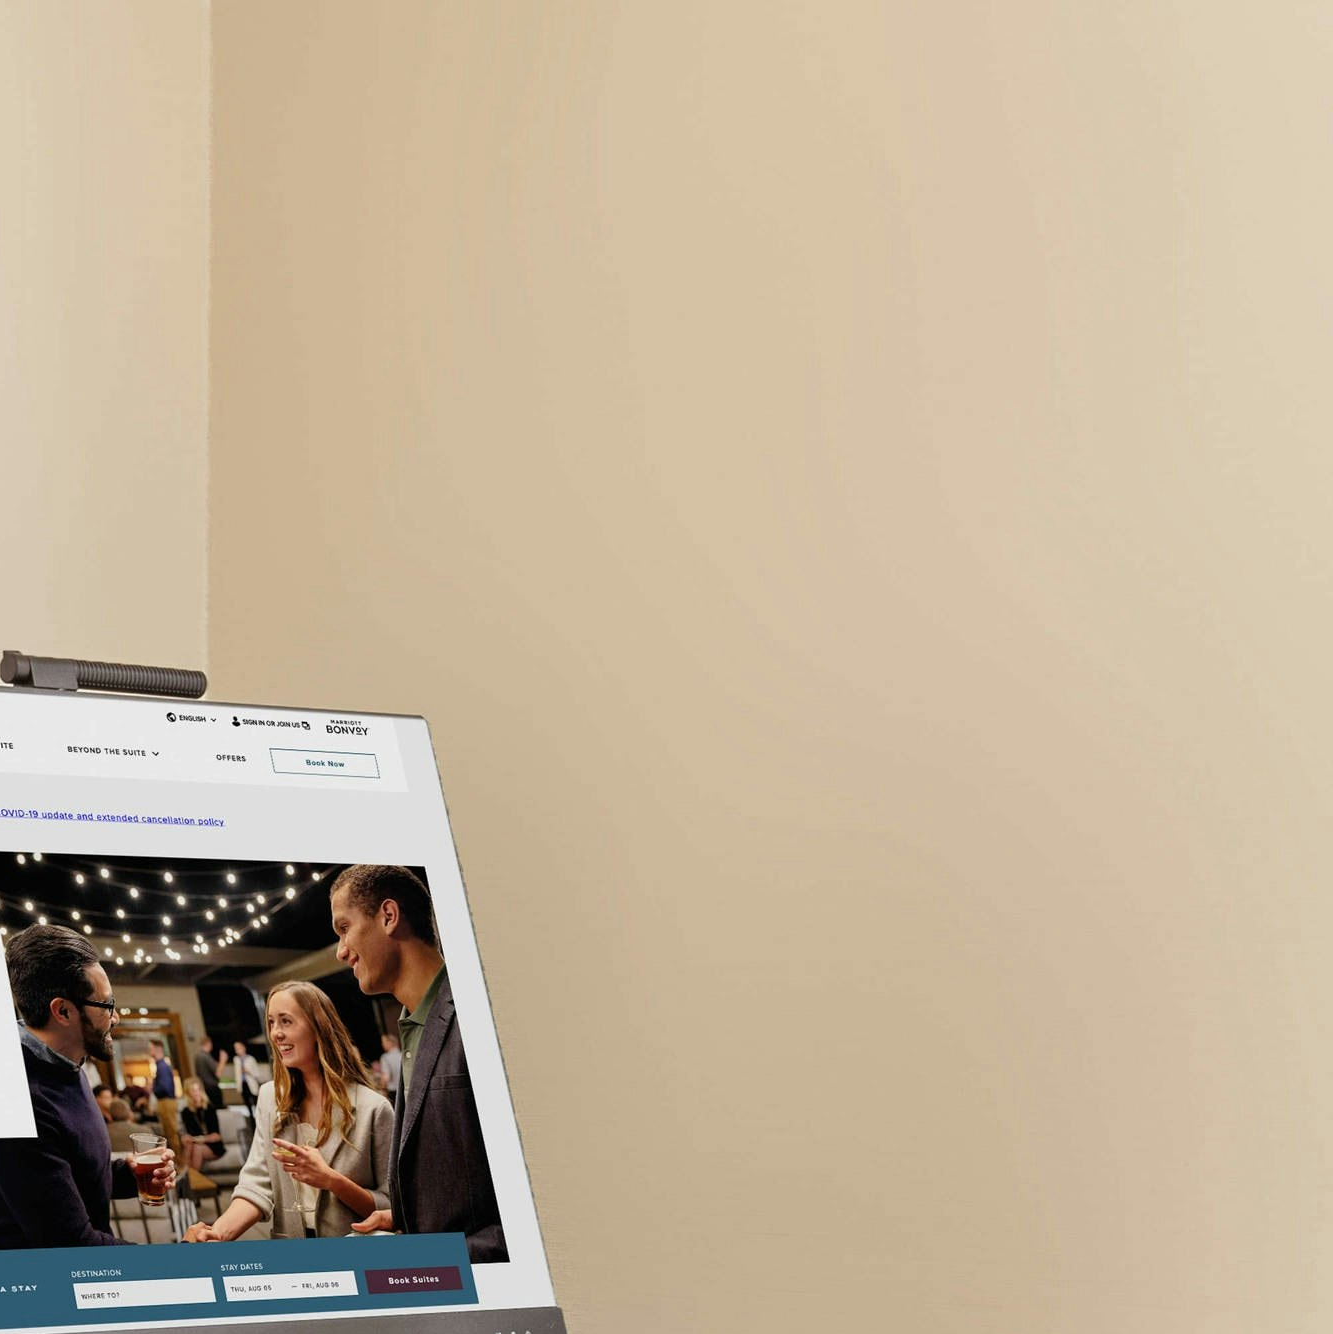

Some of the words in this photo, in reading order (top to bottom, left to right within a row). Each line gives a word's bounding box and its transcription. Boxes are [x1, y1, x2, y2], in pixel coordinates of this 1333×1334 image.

[179, 714, 206, 722] ENGLISH
[276, 720, 291, 728] JOIN
[292, 721, 301, 729] US
[326, 725, 368, 736] BONVOY
[67, 745, 102, 755] BEYOND
[104, 748, 120, 756] THE
[123, 748, 147, 757] SUITE
[216, 754, 247, 763] OFFERS
[305, 758, 326, 768] Book
[327, 760, 345, 768] Now
[41, 810, 74, 820] update
[76, 811, 94, 821] and
[96, 813, 139, 824] extended
[141, 815, 196, 826] cancellation
[198, 817, 225, 828] policy
[221, 1263, 238, 1272] STAY
[240, 1262, 264, 1271] DATES
[71, 1268, 122, 1279] DESTINATION
[388, 1275, 410, 1285] Book
[412, 1274, 440, 1284] Suites
[0, 1286, 7, 1294] A
[11, 1284, 38, 1293] STAY
[231, 1285, 247, 1293] THU,
[316, 1281, 330, 1289] AUG
[107, 1291, 120, 1299] TO?
